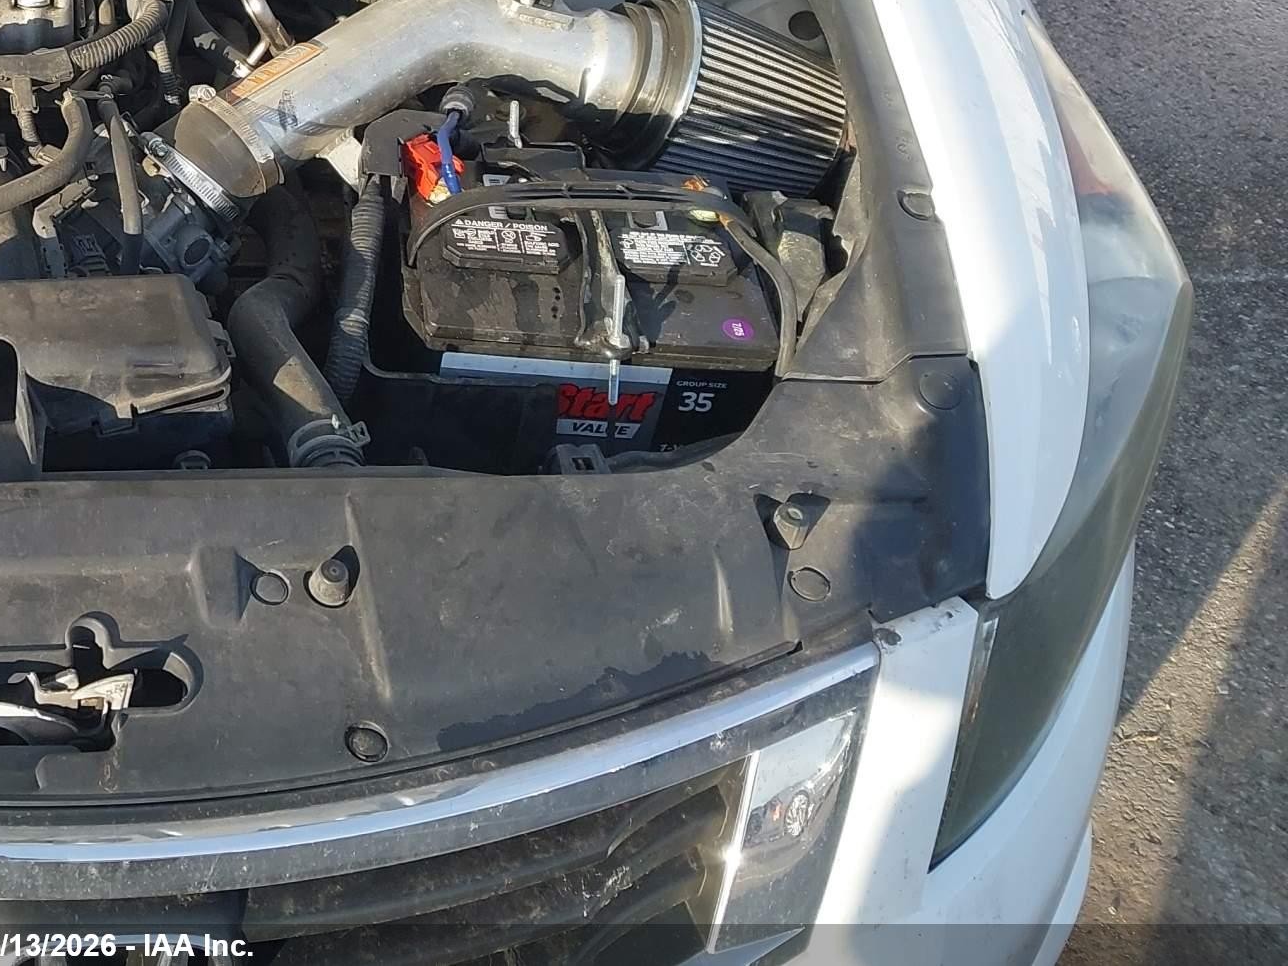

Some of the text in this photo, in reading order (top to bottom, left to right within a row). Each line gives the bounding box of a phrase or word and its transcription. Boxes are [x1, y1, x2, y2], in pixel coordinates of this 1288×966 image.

[465, 219, 504, 228] DANGER
[513, 223, 548, 231] POISON
[676, 380, 708, 388] GROUP
[678, 391, 715, 413] 35
[572, 422, 631, 436] VALE
